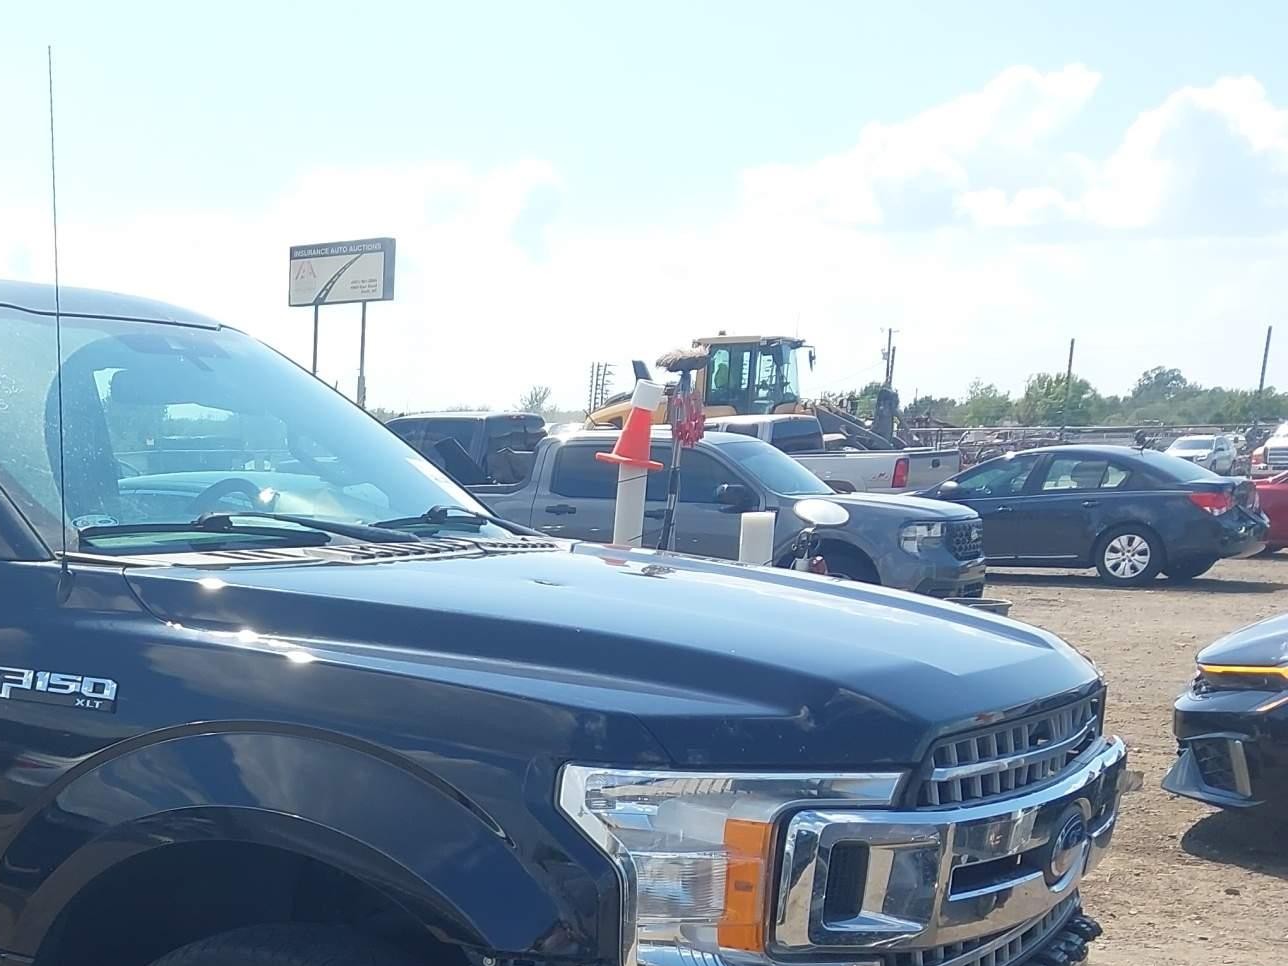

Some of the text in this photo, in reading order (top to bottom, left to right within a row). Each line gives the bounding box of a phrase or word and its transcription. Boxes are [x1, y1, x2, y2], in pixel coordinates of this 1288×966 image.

[294, 243, 382, 257] INSURANCE AUTO AUCTIONS
[74, 698, 103, 709] XLT
